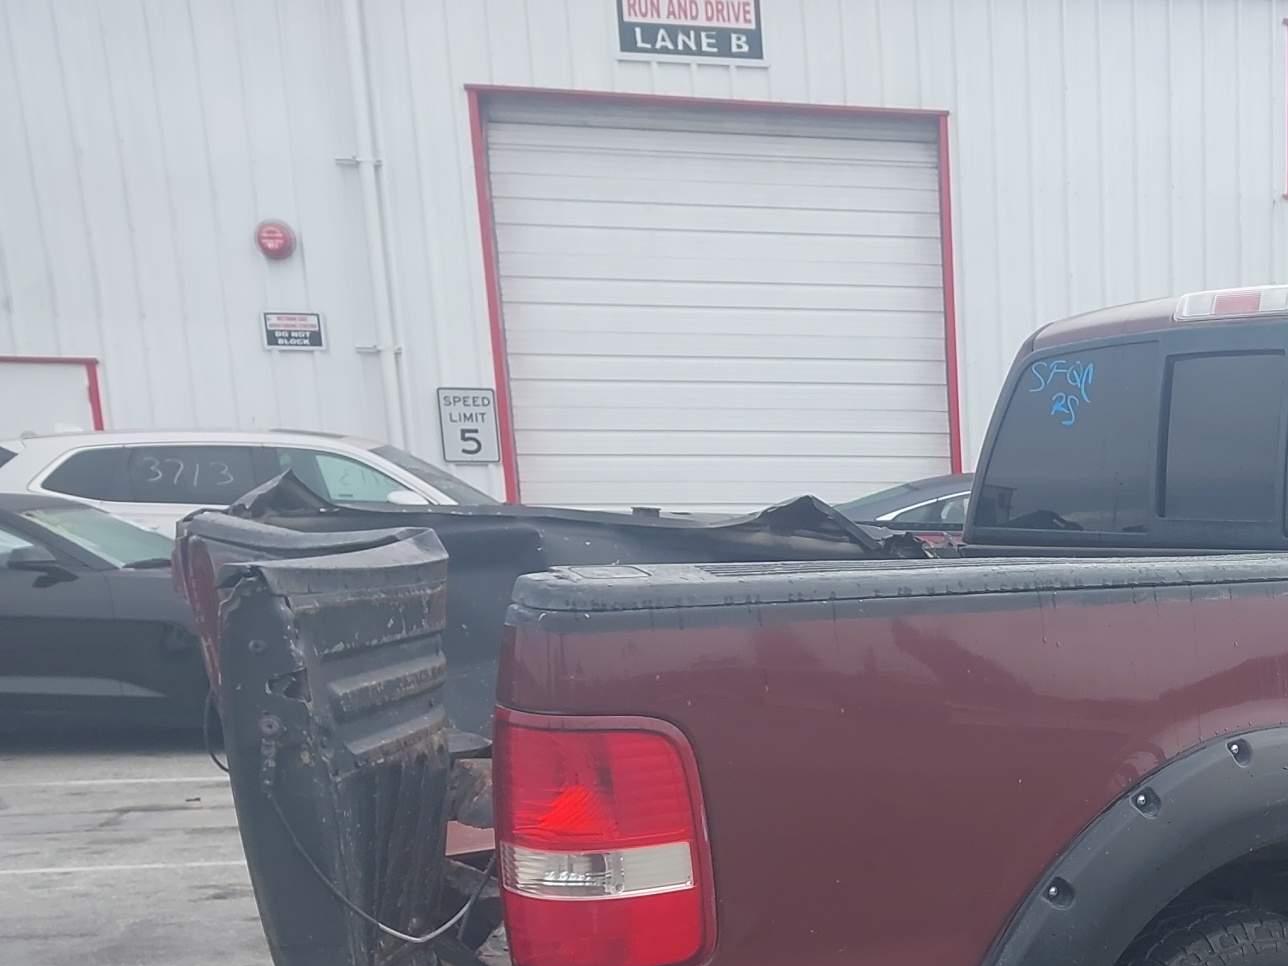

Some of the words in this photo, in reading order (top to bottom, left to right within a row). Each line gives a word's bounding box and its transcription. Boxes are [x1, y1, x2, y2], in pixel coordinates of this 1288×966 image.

[628, 0, 660, 18] RUN
[667, 0, 699, 20] AND
[704, 0, 752, 23] DRIVE
[635, 27, 718, 52] LANE
[731, 33, 749, 52] B
[443, 396, 490, 407] SPEED
[449, 412, 486, 423] LIMIT
[460, 428, 482, 454] 5
[143, 457, 234, 487] 3713
